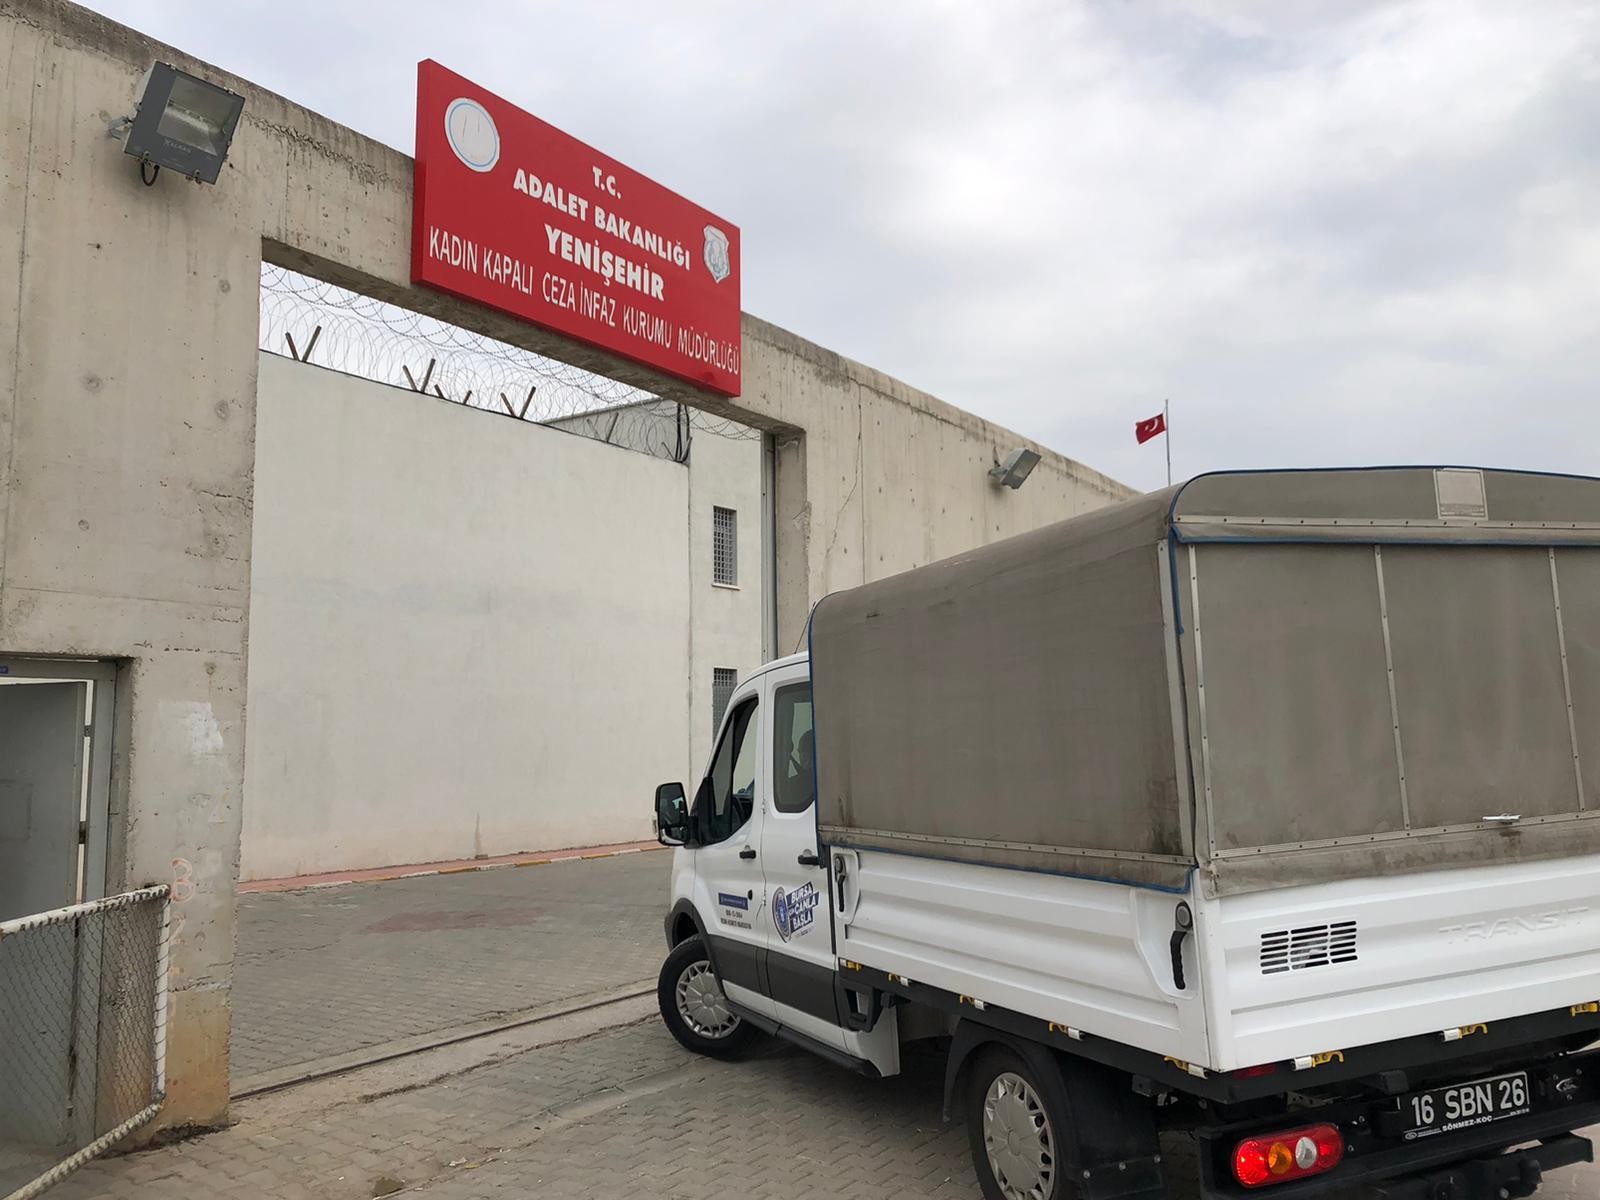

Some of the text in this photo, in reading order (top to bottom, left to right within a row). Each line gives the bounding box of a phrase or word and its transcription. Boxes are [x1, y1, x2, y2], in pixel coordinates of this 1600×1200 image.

[592, 165, 622, 200] T.C.
[513, 167, 691, 271] ADALET BAKANLIĞI
[544, 223, 665, 302] YENİŞEHİR
[429, 225, 739, 376] KADIN KAPALI CEZA İNFAZ KURUMU MÜDÜRLÜĞÜ
[1438, 905, 1590, 944] TRANSIT
[1411, 1094, 1435, 1126] 16
[1444, 1083, 1494, 1120] SBN
[1498, 1078, 1525, 1110] 26
